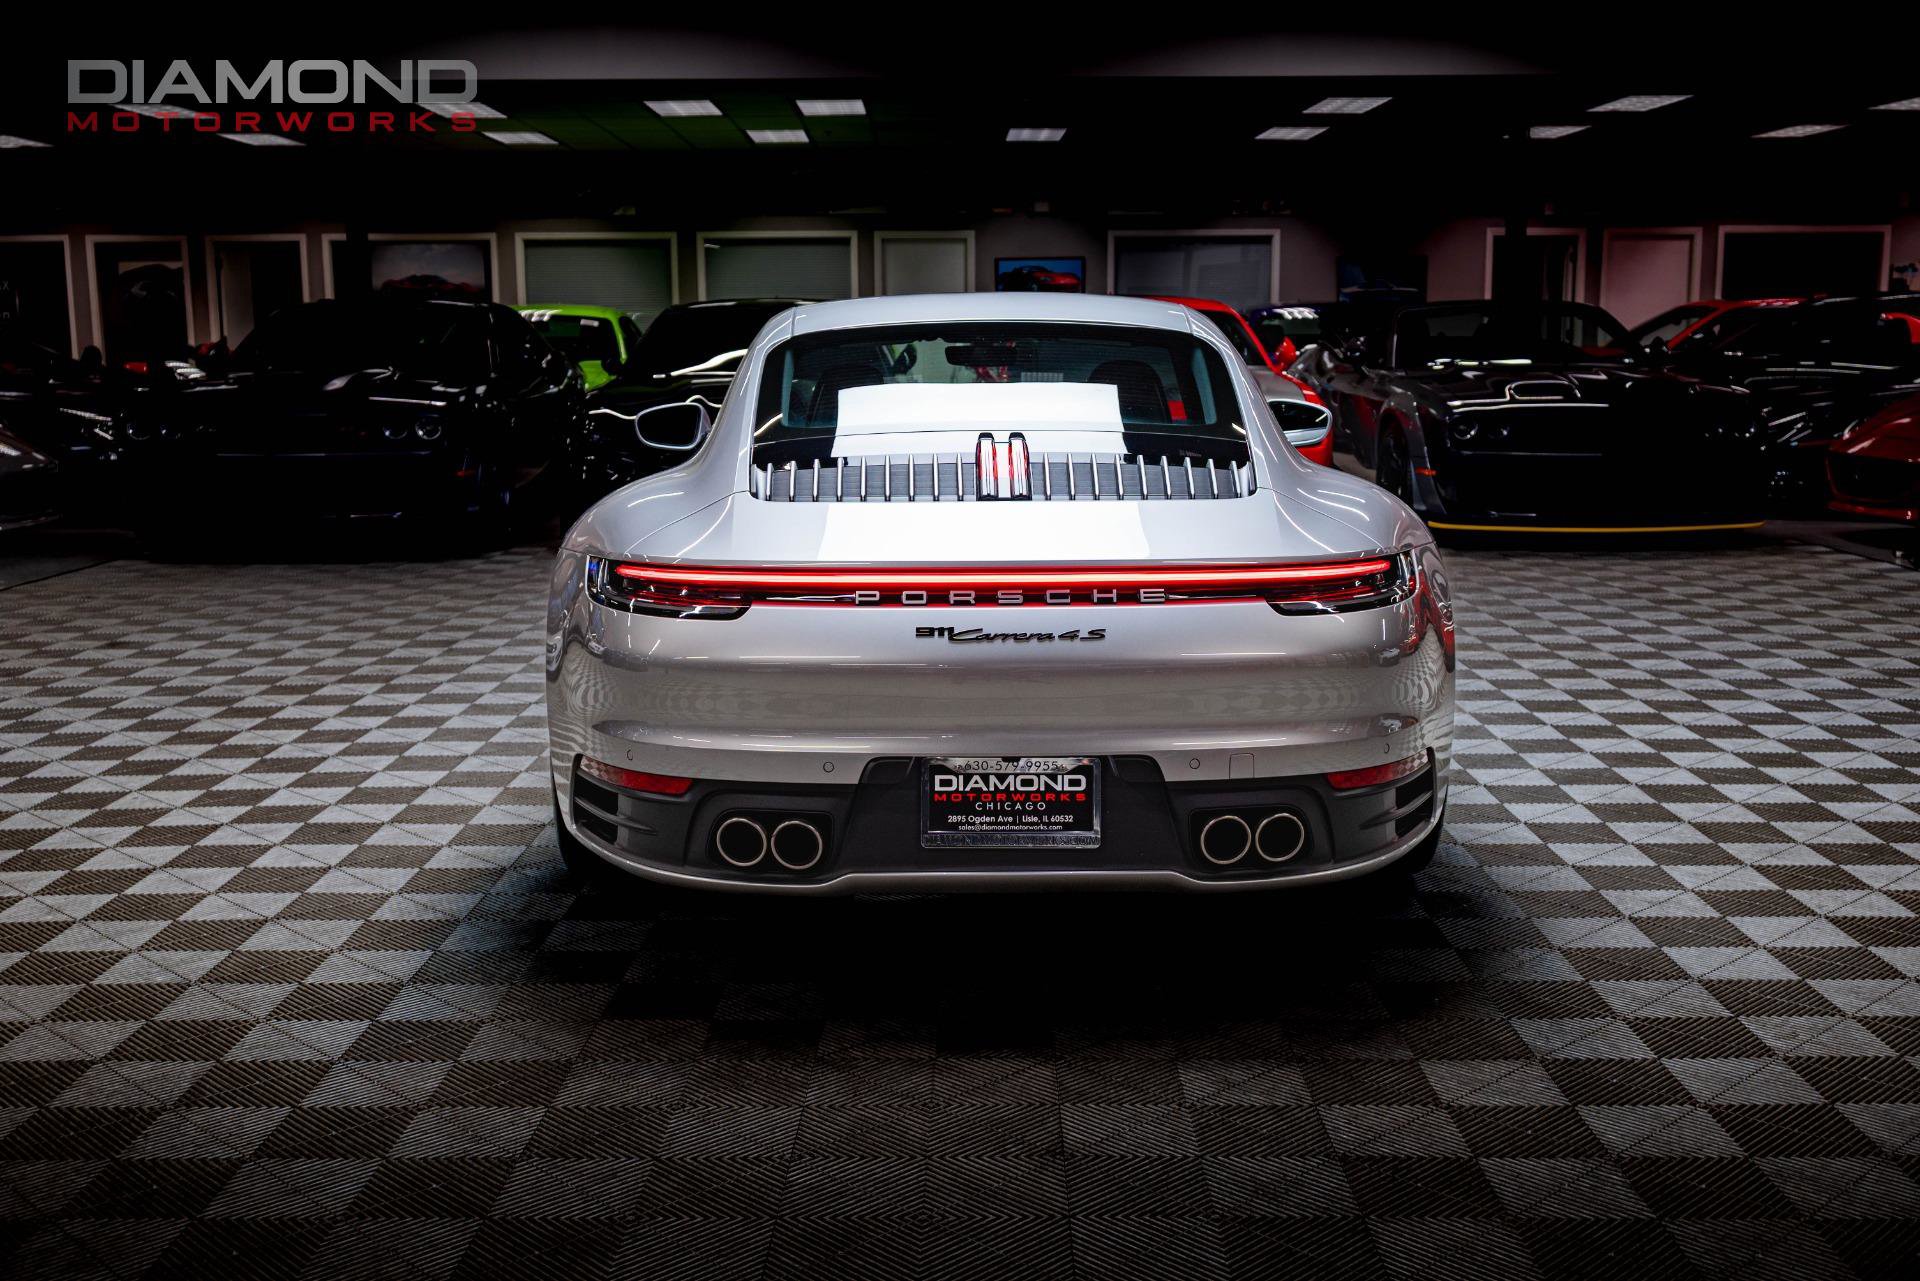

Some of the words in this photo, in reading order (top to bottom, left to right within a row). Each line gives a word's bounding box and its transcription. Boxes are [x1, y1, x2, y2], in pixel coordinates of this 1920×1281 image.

[855, 589, 1166, 605] PORSCHE
[915, 626, 954, 637] 911
[949, 628, 1056, 642] Carrera
[963, 760, 1058, 771] 630-579-9955
[934, 774, 1087, 792] DIAMOND
[933, 793, 1087, 802] MOTORWORKS
[975, 802, 1047, 811] CHICAGO
[947, 815, 967, 823] 2895
[967, 815, 996, 824] Ogden
[997, 815, 1013, 823] Ave
[1043, 815, 1050, 823] IL
[1050, 815, 1074, 823] 60532
[958, 824, 1063, 832] sales@diamondmotorworks.com
